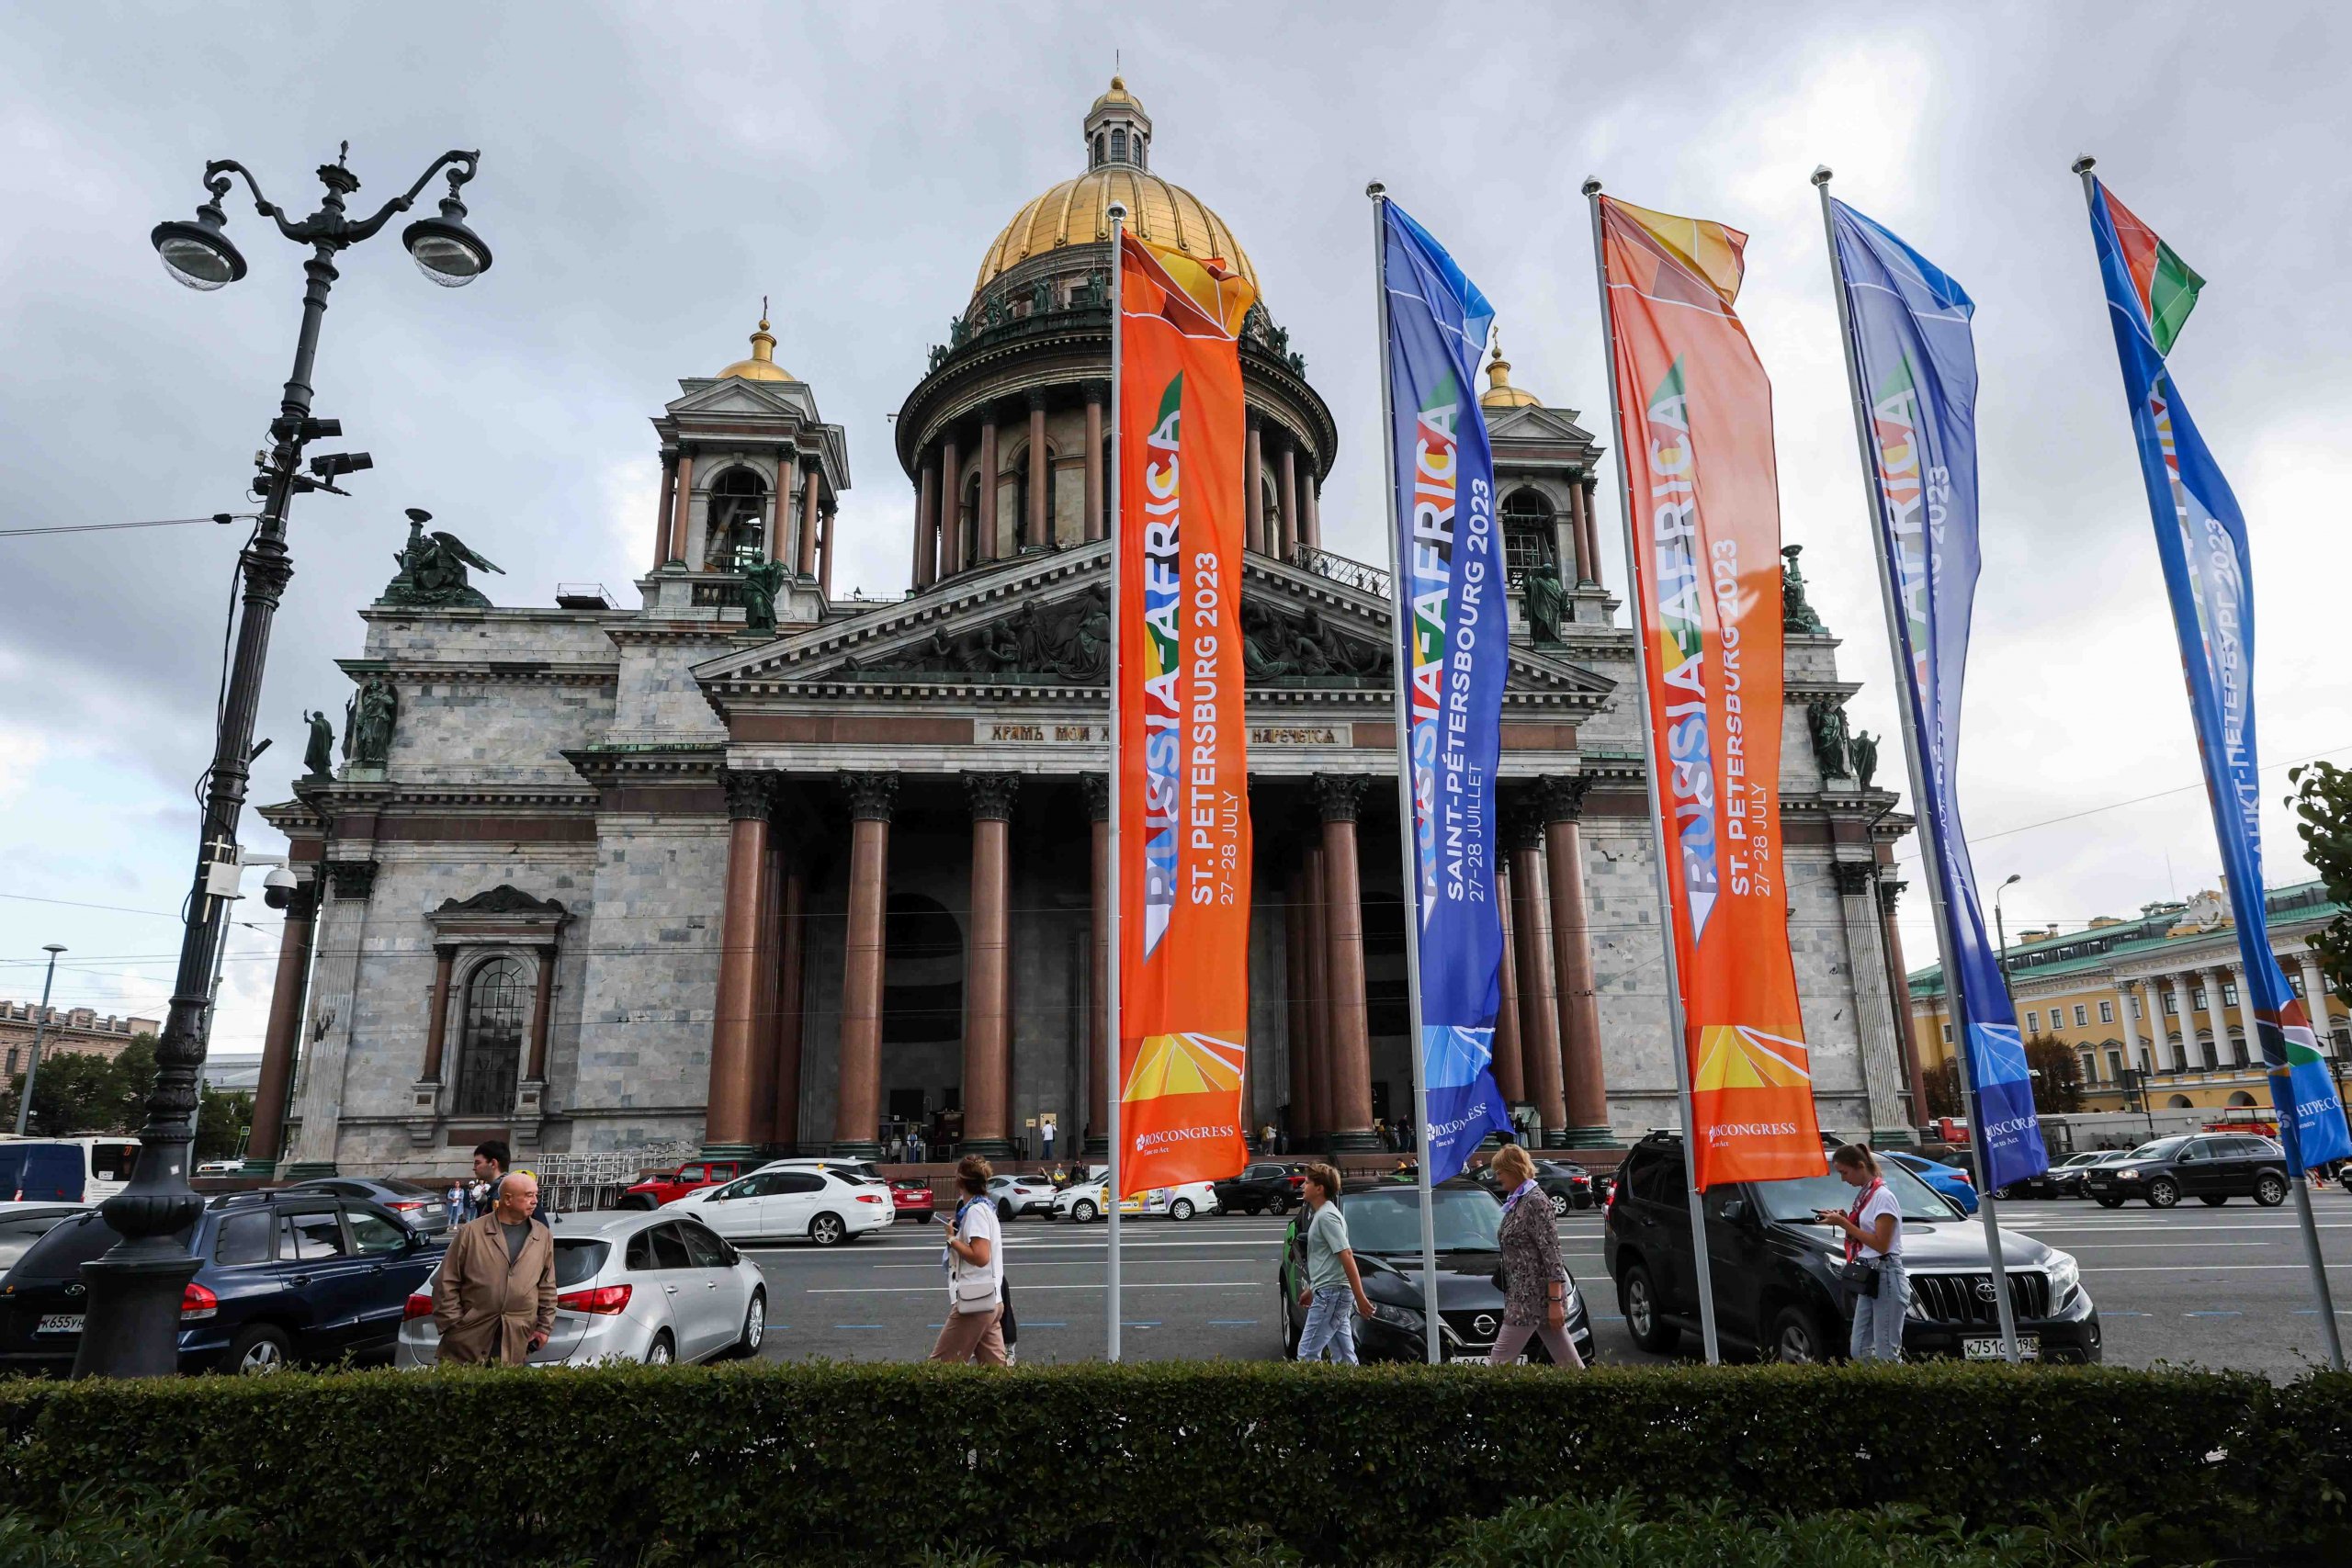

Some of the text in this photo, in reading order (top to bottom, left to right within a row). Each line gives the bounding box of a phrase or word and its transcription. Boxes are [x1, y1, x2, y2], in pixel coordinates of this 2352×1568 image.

[1927, 466, 1950, 545] 2023
[2205, 518, 2231, 586] 2023
[1191, 552, 1219, 906] ST. PETERSBURG 2023
[1441, 478, 1490, 902] SAINT-PÉTERSBOURG 2023
[1712, 539, 1749, 897] ST. PETERSBURG 2023
[1222, 790, 1239, 838] JULY
[1467, 761, 1484, 839] JUILLET
[1751, 782, 1768, 829] JULY
[1145, 1124, 1234, 1146] ROSCONGRESS
